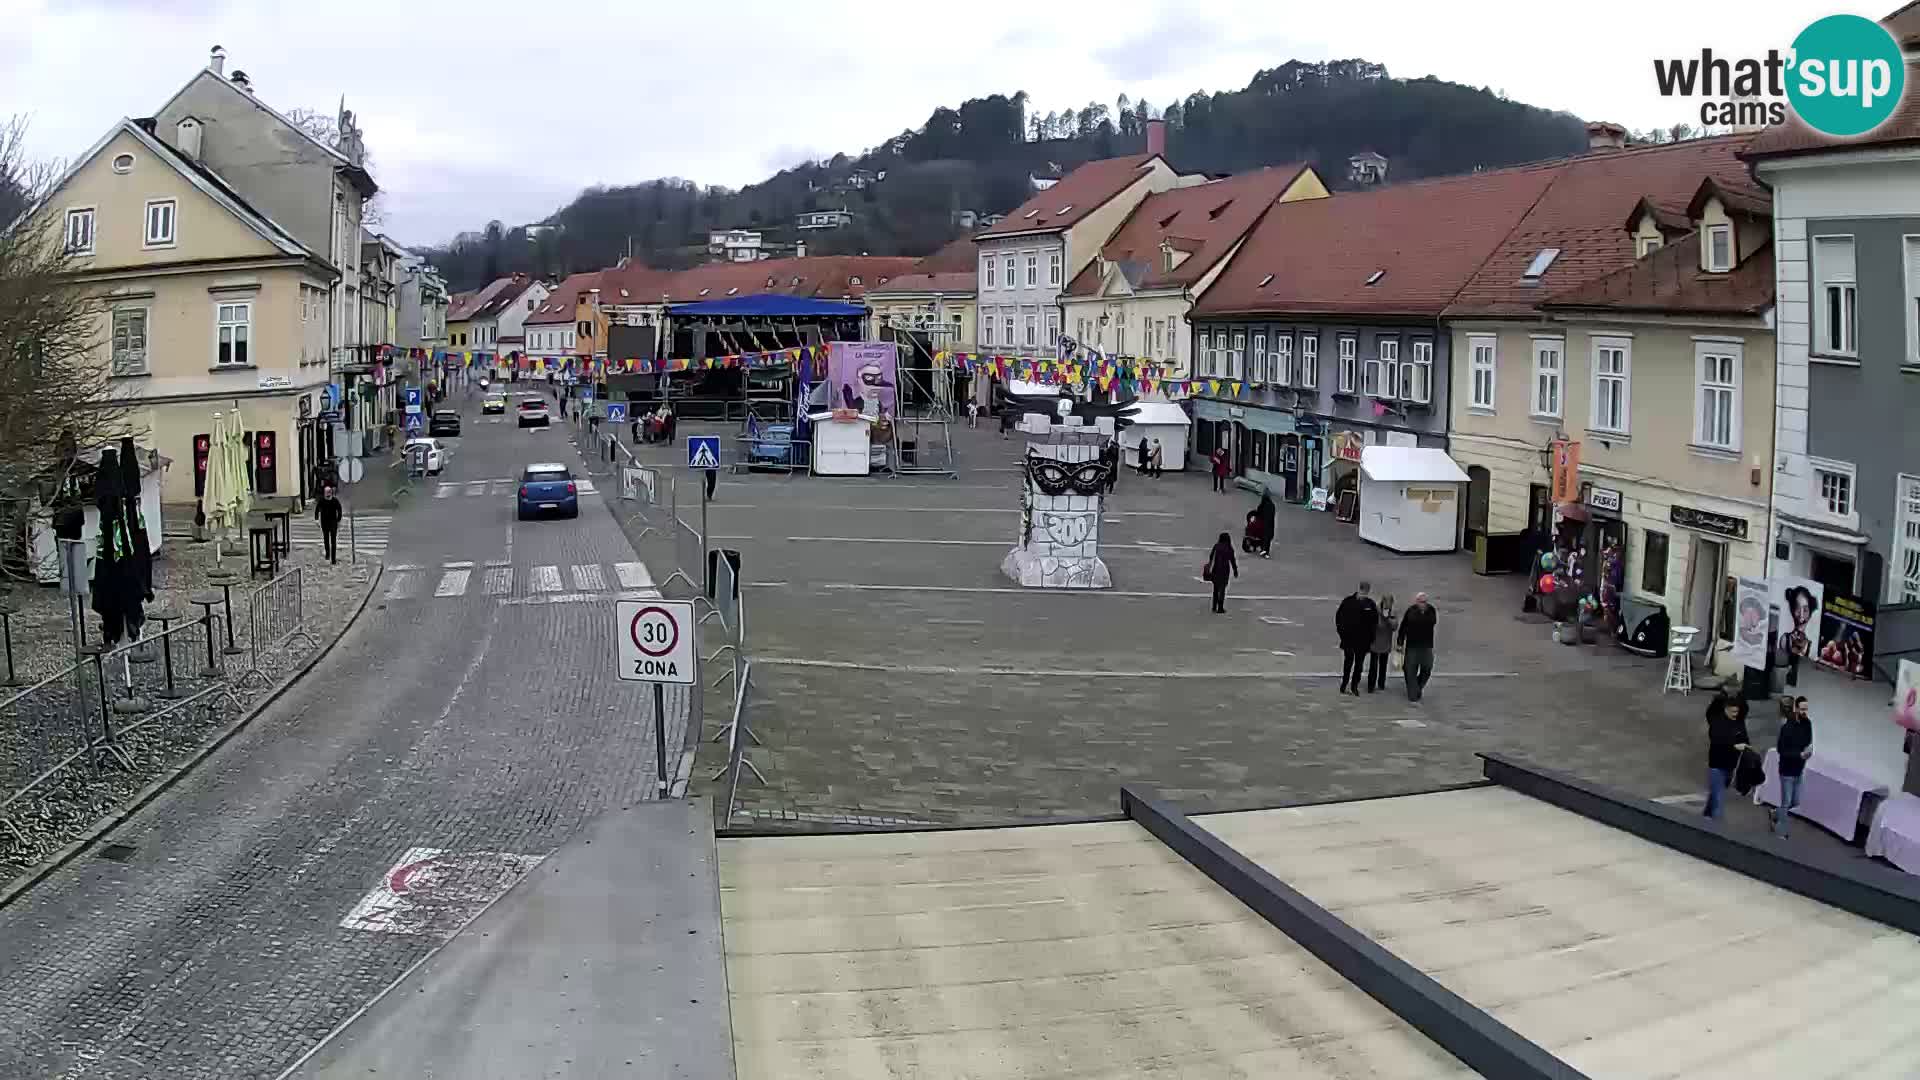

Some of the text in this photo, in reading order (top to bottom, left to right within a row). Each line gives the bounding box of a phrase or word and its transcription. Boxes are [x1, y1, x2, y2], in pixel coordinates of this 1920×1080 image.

[409, 391, 417, 403] P
[799, 383, 810, 423] Ford
[1048, 516, 1087, 545] 200
[643, 622, 667, 643] 30
[634, 660, 678, 676] ZONA
